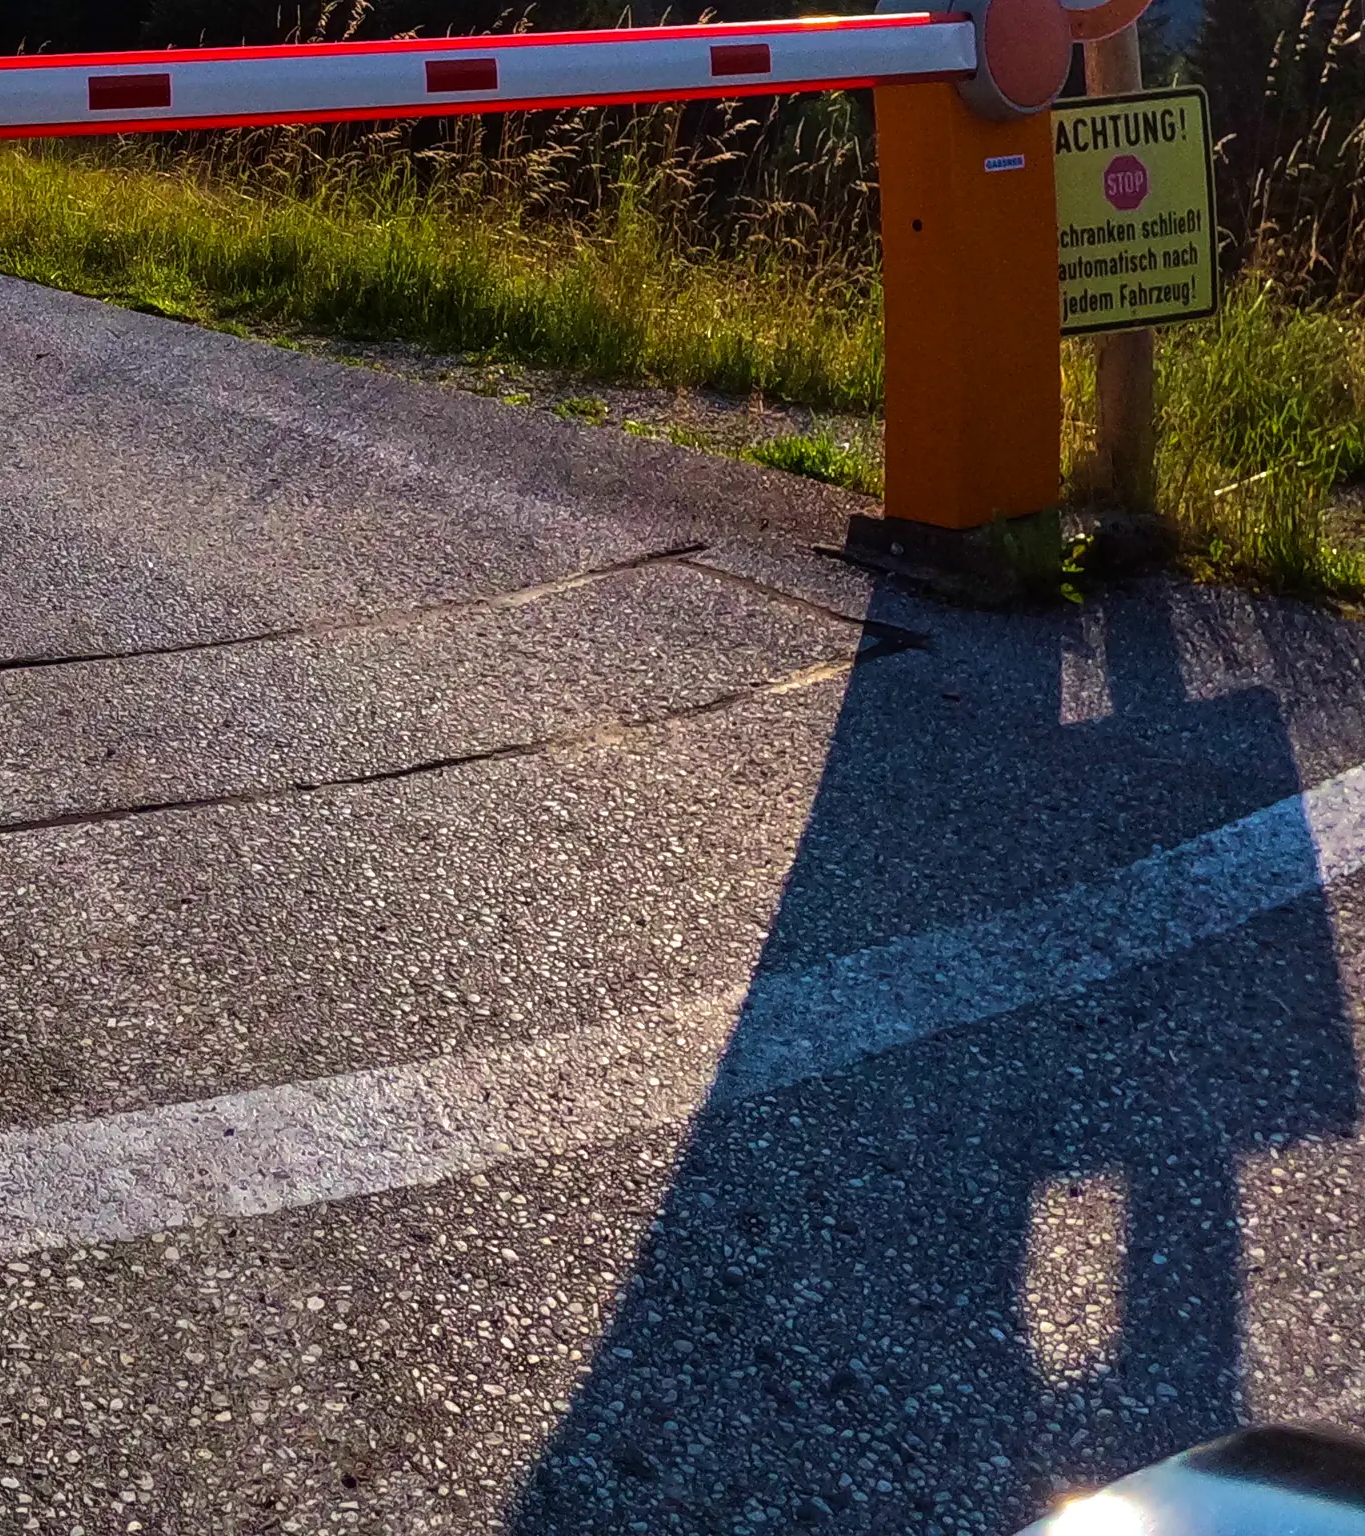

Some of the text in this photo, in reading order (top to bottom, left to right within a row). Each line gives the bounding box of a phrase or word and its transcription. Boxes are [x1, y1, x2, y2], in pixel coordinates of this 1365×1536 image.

[1055, 107, 1187, 154] ACHTUNG!
[1107, 171, 1144, 195] STOP
[1060, 209, 1202, 248] chranken schließt
[1058, 241, 1198, 281] automatisch nach
[1062, 275, 1196, 322] jedem Fahrzeug!
